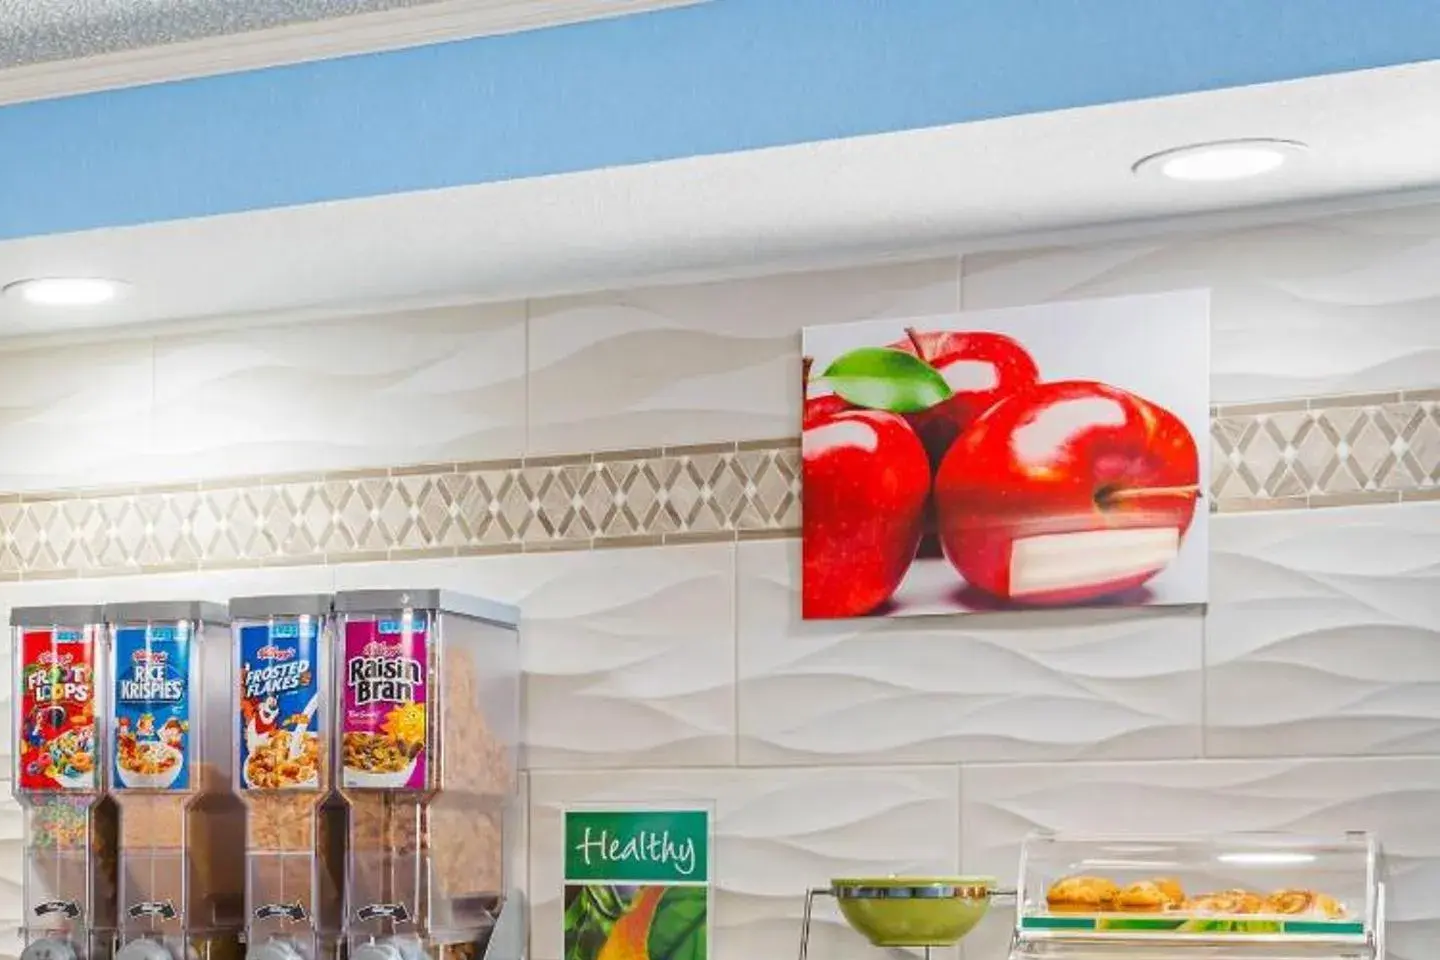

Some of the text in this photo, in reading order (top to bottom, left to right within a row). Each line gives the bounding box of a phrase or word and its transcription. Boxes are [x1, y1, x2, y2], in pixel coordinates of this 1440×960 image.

[135, 665, 165, 682] RICE
[246, 660, 310, 686] FROSTED
[349, 657, 421, 685] Raisin
[36, 683, 89, 702] LOOPS
[121, 680, 182, 700] KRISPIES
[246, 675, 299, 698] FLAKES
[356, 680, 412, 704] Bran
[575, 827, 696, 875] Healthy
